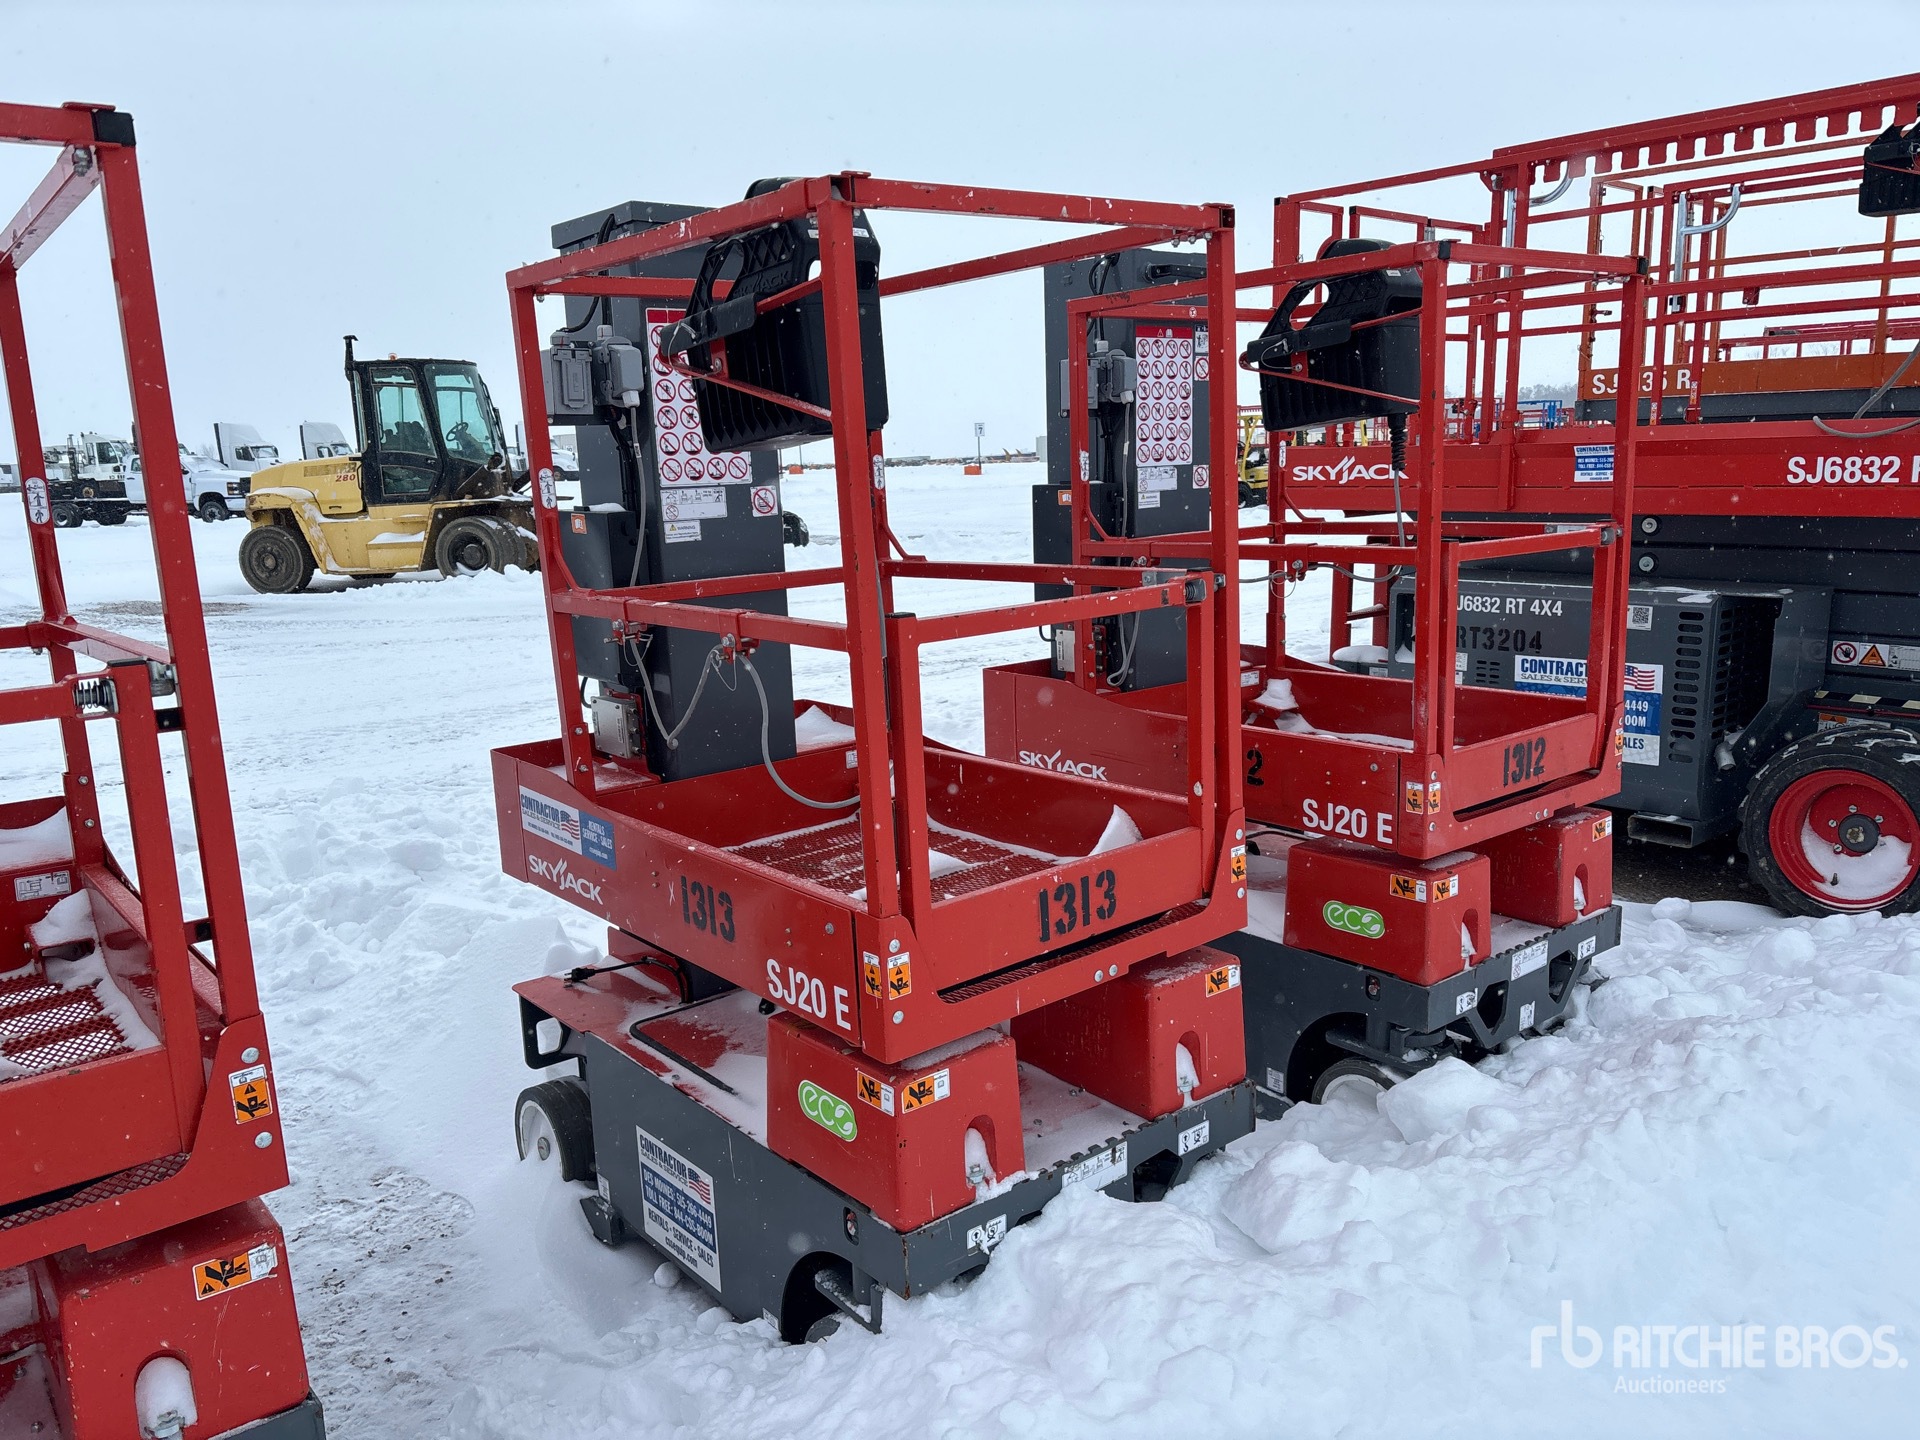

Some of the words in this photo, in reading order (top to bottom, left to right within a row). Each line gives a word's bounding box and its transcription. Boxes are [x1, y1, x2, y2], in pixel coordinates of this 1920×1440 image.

[336, 473, 356, 482] 280
[1292, 455, 1409, 485] SKYJACK
[1786, 455, 1901, 484] SJ6832
[1456, 595, 1501, 614] J6832
[1505, 597, 1526, 615] RT
[1529, 599, 1563, 617] 4X4
[1456, 625, 1543, 654] RT3204
[1520, 657, 1587, 677] CONTRACT
[1520, 673, 1552, 682] SALES
[1624, 699, 1649, 713] 4449
[1624, 714, 1647, 727] OOM
[1623, 736, 1645, 750] ALES
[1246, 749, 1264, 786] 2
[1503, 736, 1546, 788] 1312
[521, 793, 560, 823] CONTRACTOR
[1302, 798, 1368, 838] SJ20
[1377, 812, 1393, 844] E
[582, 828, 598, 843] SERVICE
[588, 820, 605, 836] RENTALS
[528, 854, 604, 905] SKYJACK
[681, 875, 735, 943] 1313
[1039, 869, 1116, 942] 1313
[766, 958, 827, 1019] SJ20
[833, 985, 851, 1031] E
[639, 1134, 687, 1179] CONTRACTOR
[640, 1149, 658, 1166] SALES
[663, 1165, 688, 1187] SERVICE
[643, 1168, 653, 1186] DES
[654, 1176, 676, 1202] MOINES:
[645, 1185, 658, 1204] TOLL
[658, 1194, 673, 1216] FREE:
[648, 1208, 669, 1233] RENTALS
[672, 1226, 694, 1252] SERVICE
[697, 1245, 714, 1268] SALES
